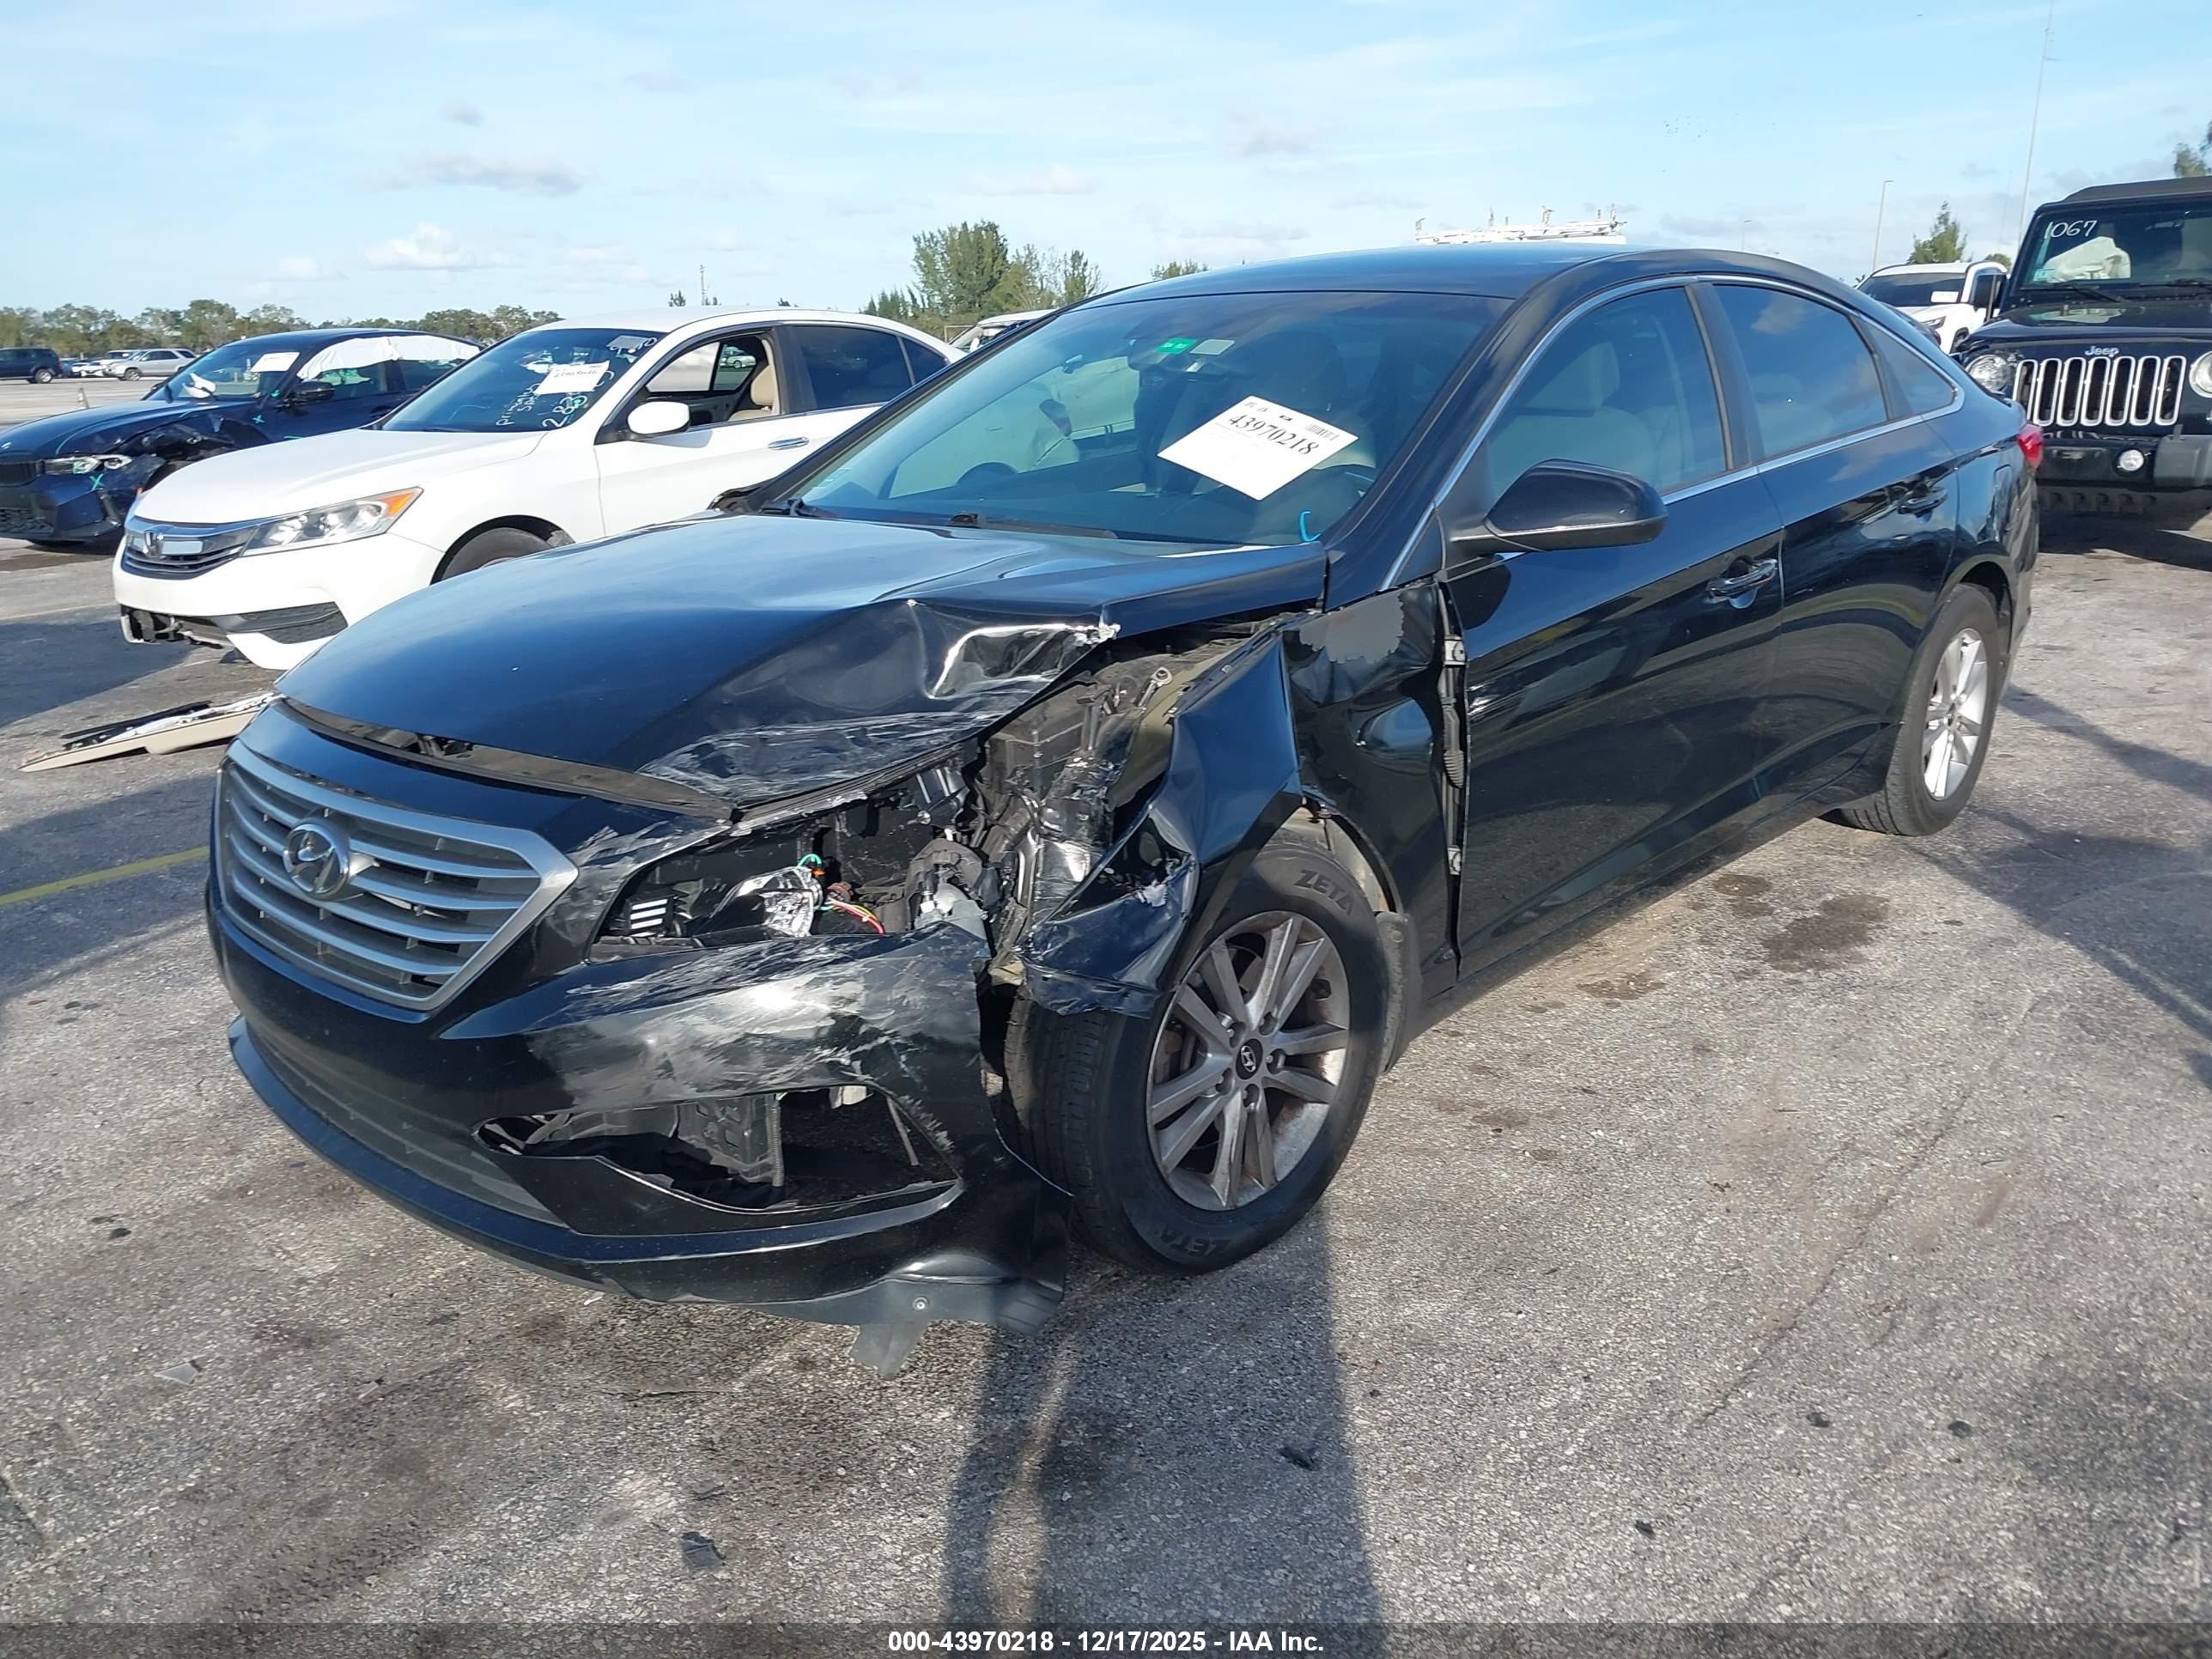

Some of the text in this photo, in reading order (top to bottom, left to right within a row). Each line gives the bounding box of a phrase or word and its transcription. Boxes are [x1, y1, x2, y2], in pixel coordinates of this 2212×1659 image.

[2044, 220, 2097, 239] 1067
[2084, 345, 2119, 357] Jeep
[1228, 414, 1320, 455] 43970218
[1294, 869, 1352, 915] ZETA
